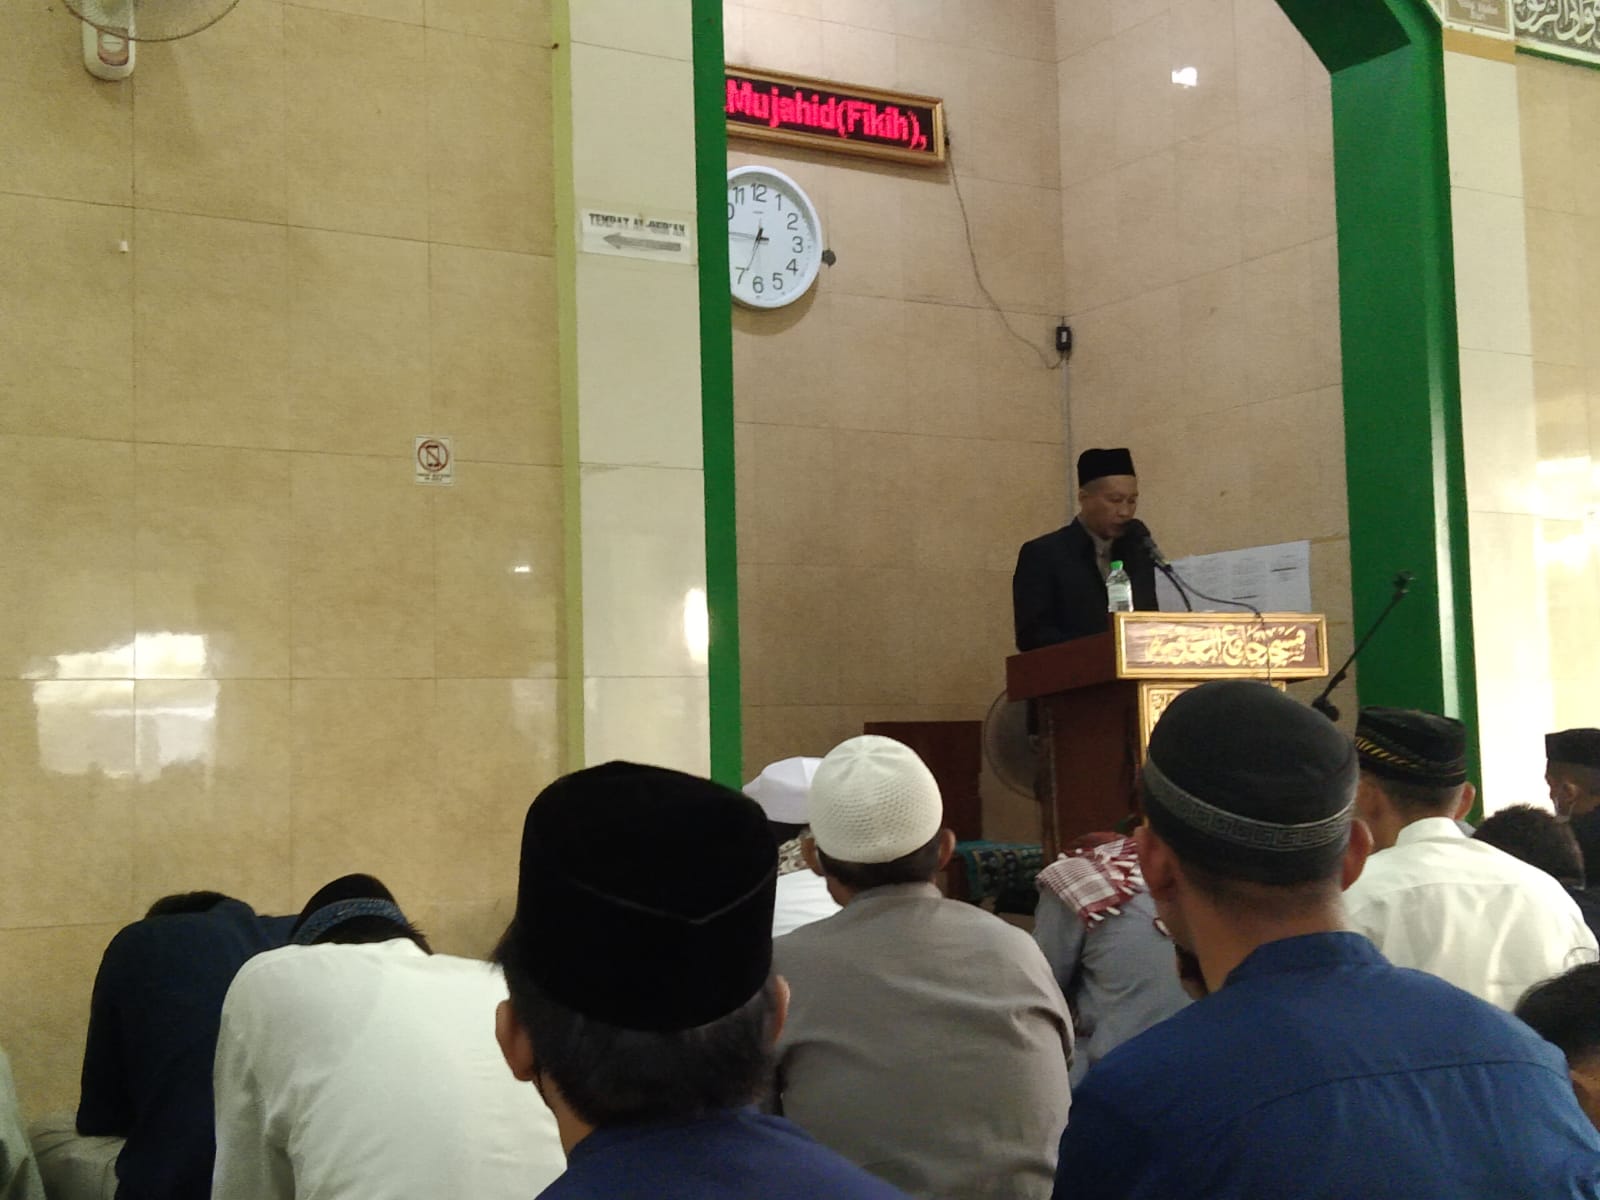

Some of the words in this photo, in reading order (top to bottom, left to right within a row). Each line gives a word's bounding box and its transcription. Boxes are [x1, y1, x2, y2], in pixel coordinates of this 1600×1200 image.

[733, 186, 745, 206] 11
[751, 183, 767, 203] 12
[775, 193, 783, 211] 1
[787, 212, 799, 231] 2
[792, 236, 803, 254] 3
[735, 266, 746, 285] 7
[786, 258, 799, 276] 4
[752, 276, 764, 294] 6
[772, 272, 784, 291] 5
